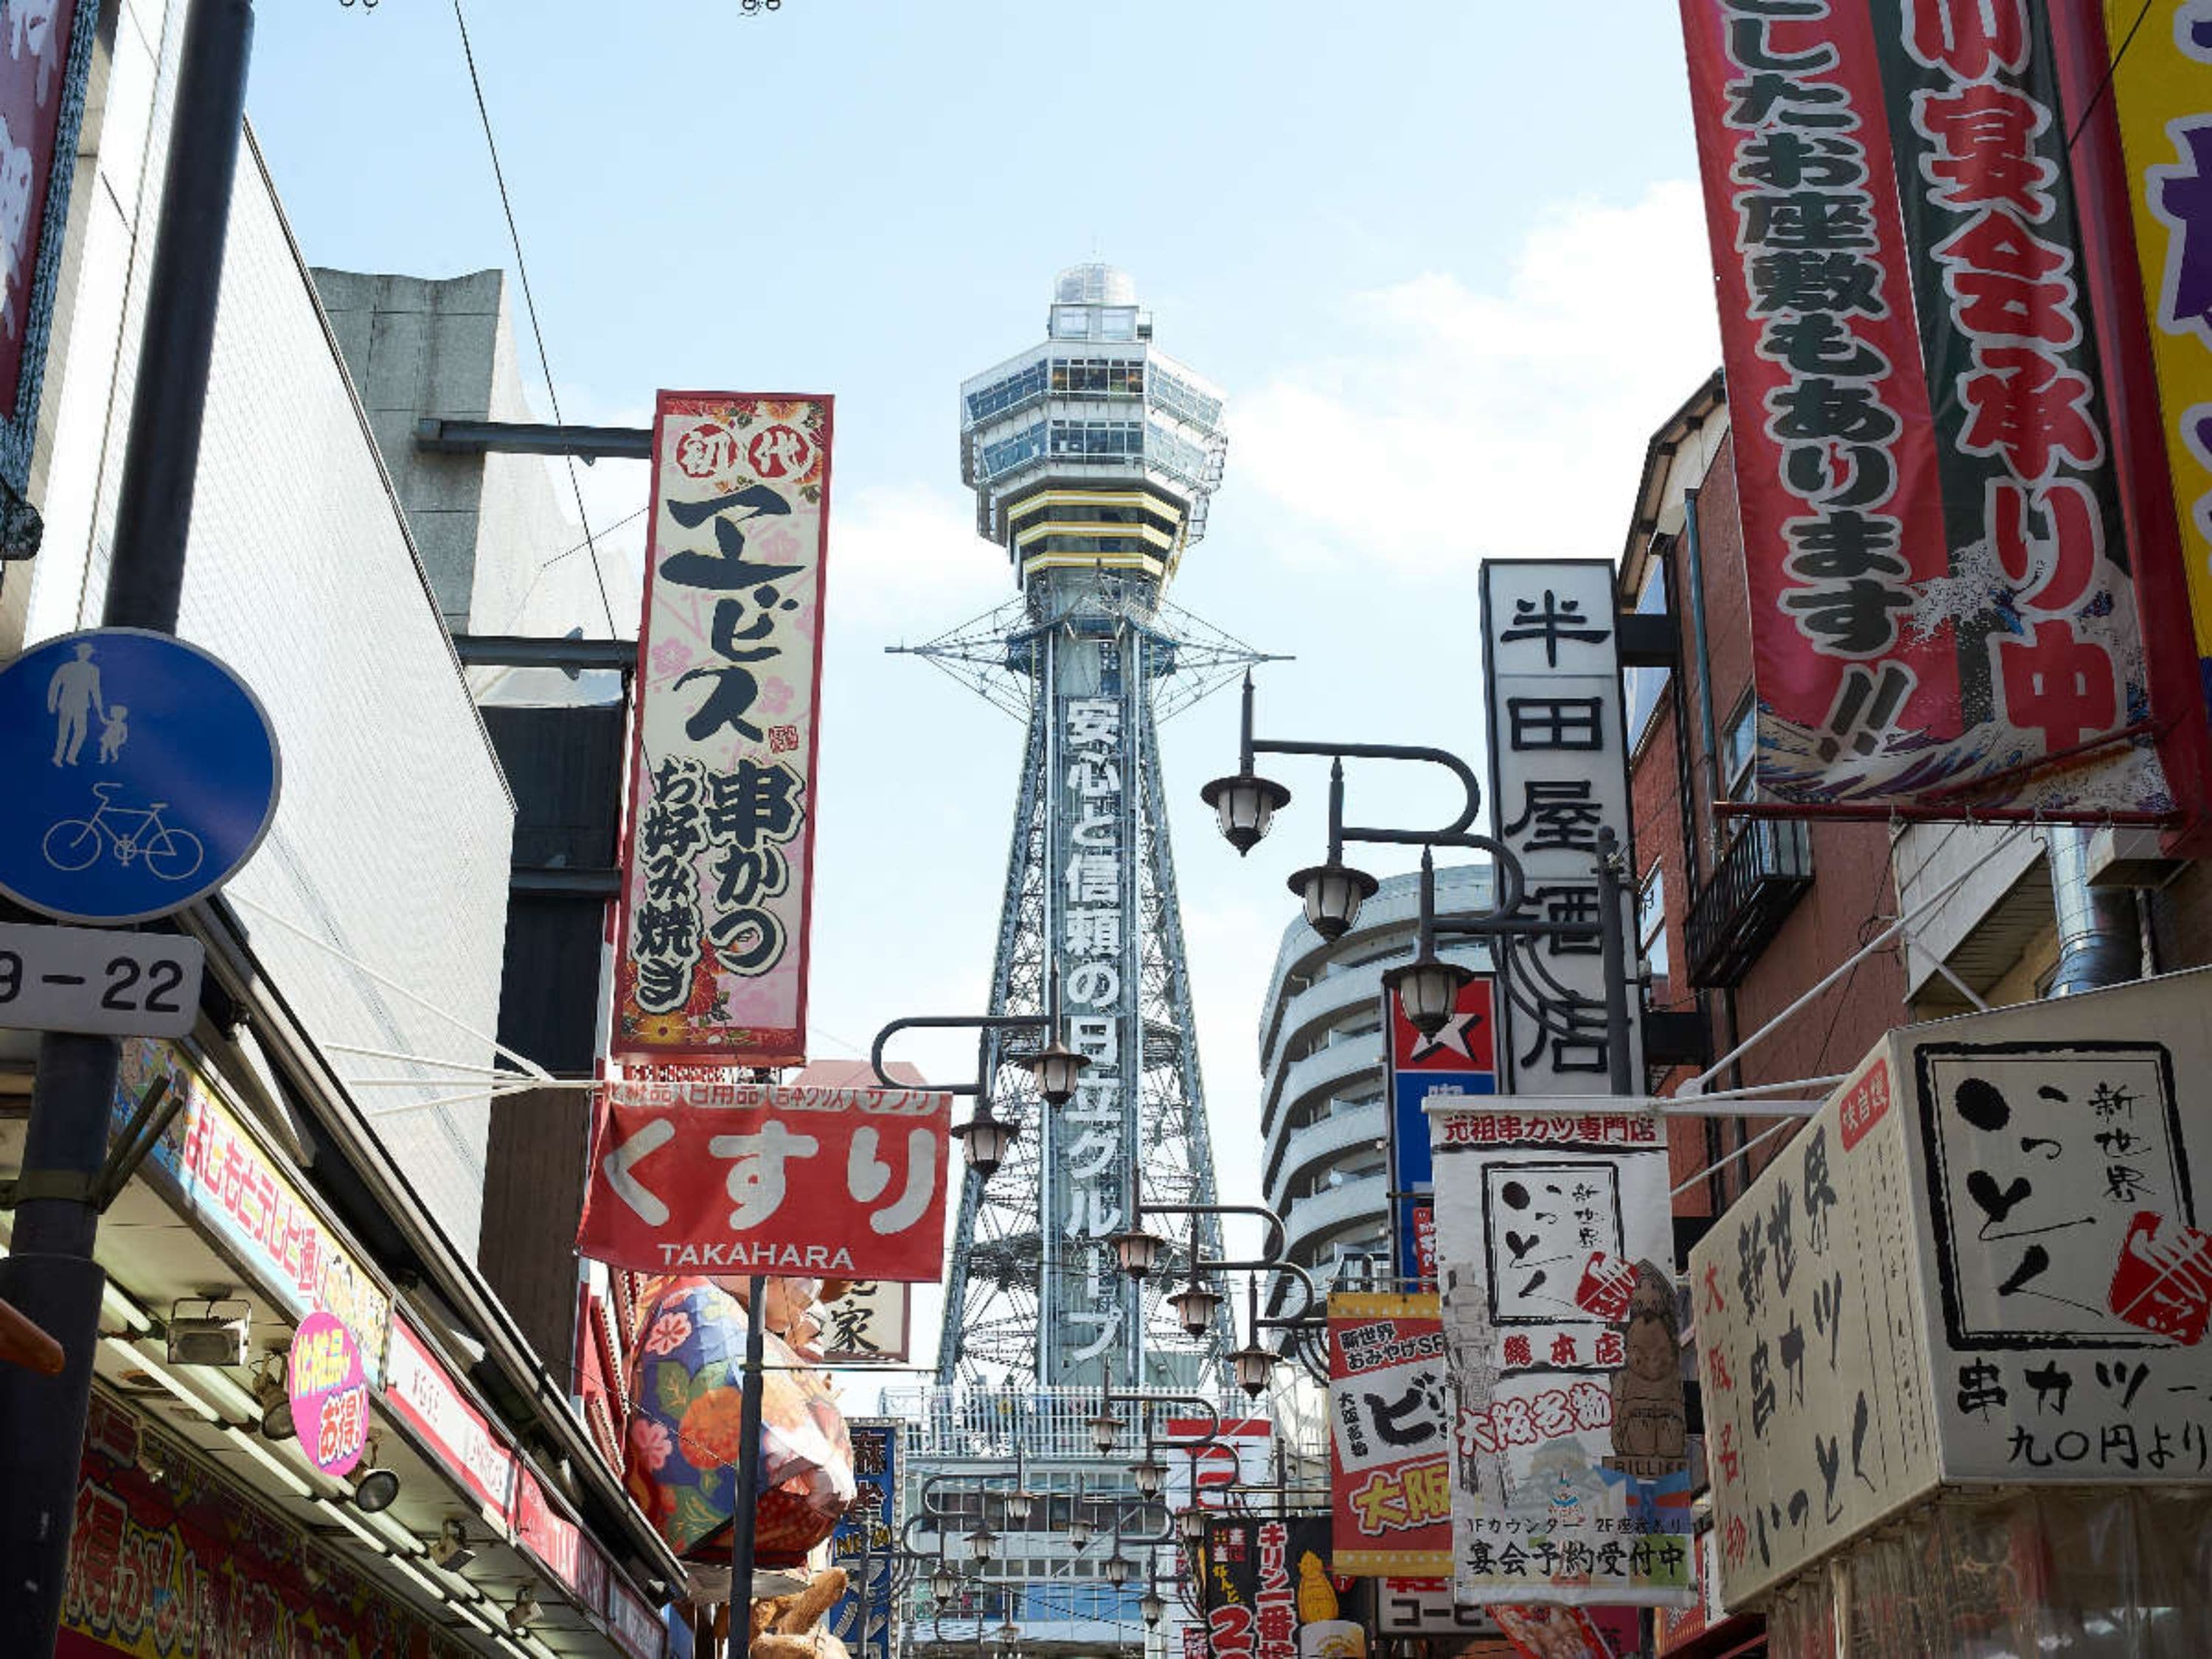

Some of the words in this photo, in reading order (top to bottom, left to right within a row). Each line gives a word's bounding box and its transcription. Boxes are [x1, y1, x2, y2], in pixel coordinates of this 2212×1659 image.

[1721, 0, 1919, 764] したお座敷もあります!!
[658, 484, 807, 743] エビス
[634, 754, 709, 1015] お好み焼き
[705, 757, 806, 978] 串かつ
[1500, 589, 1612, 1074] 半田屋酒店
[1065, 699, 1123, 1361] 安心と信頼の日立グループ
[603, 1118, 936, 1235] くすり
[1444, 1114, 1657, 1142] 元祖串カツ専門店
[2087, 1081, 2157, 1203] 新世界
[658, 1242, 855, 1271] TAKAHARA
[1340, 1321, 1396, 1350] 新世界
[1504, 1332, 1624, 1365] 総本店
[1958, 1357, 2212, 1423] 串カツ一
[1352, 1464, 1450, 1530] 大阪
[1466, 1539, 1686, 1578] 宴会予約受付中
